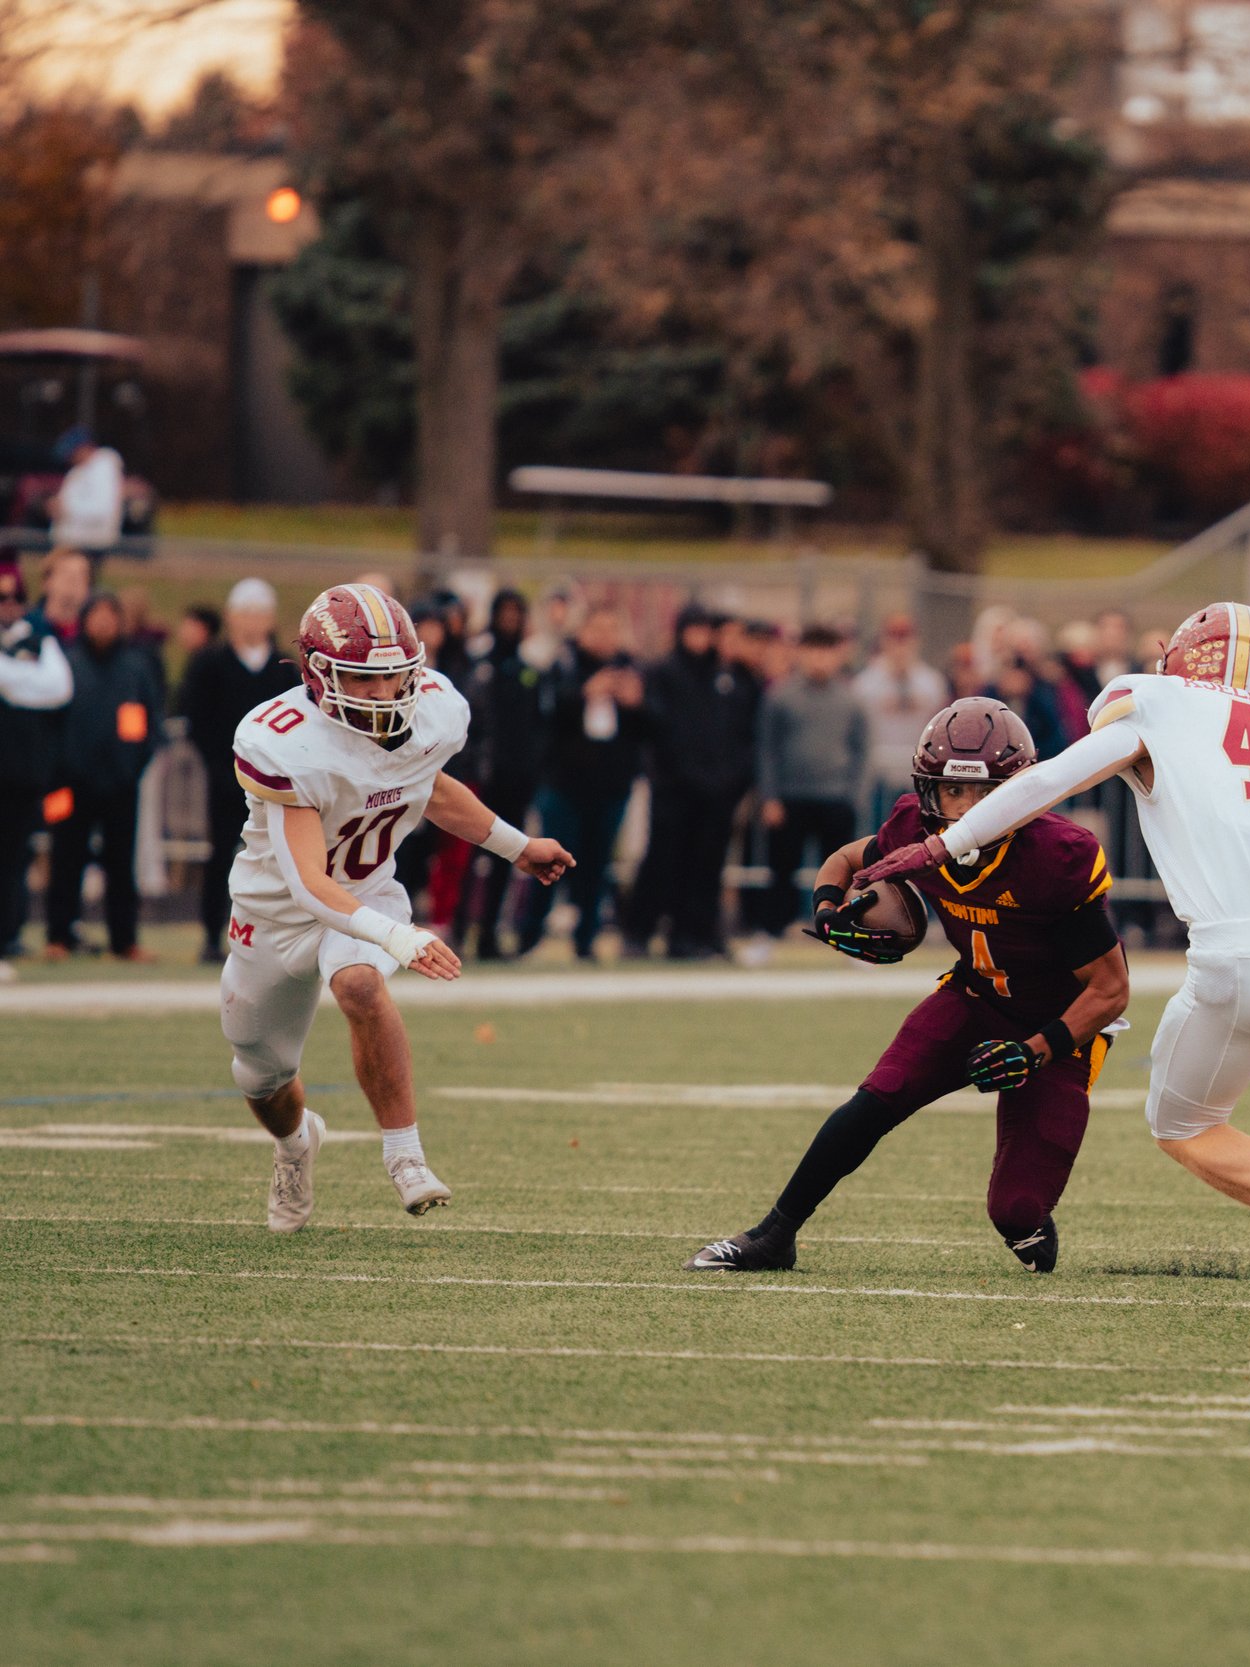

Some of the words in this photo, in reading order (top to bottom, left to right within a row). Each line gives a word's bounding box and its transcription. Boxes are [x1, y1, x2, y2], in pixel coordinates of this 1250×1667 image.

[251, 700, 306, 734] 10
[364, 786, 404, 809] MORRIS
[325, 803, 410, 880] 10
[228, 915, 256, 948] M
[971, 928, 1012, 998] 4
